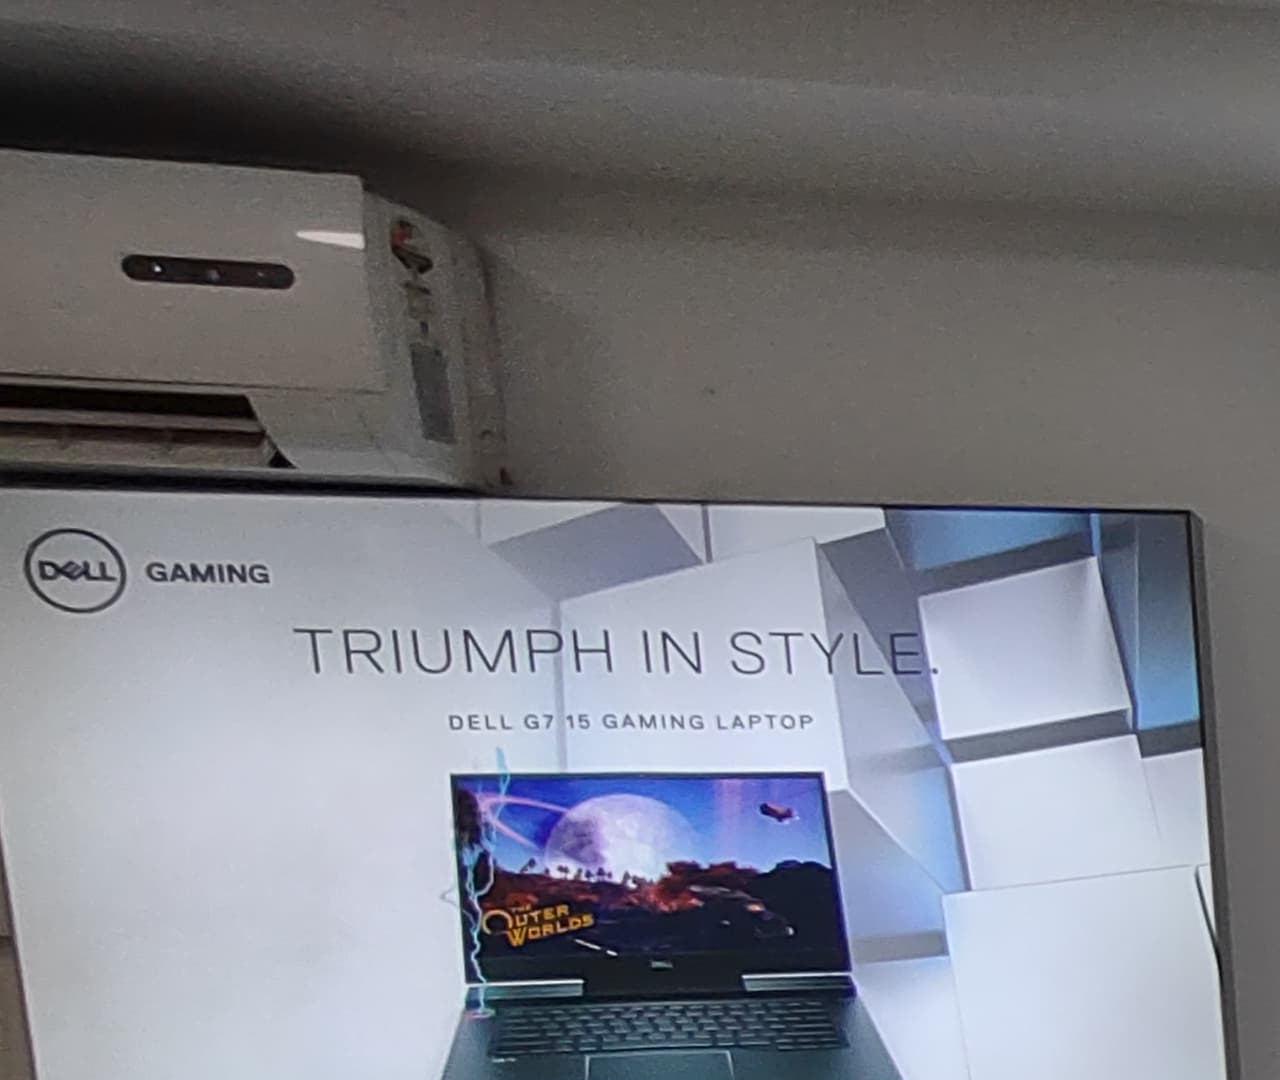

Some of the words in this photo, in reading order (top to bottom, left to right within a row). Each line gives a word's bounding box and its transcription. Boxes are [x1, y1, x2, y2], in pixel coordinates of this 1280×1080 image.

[38, 560, 117, 581] DELL
[146, 562, 270, 583] GAMING
[293, 628, 613, 674] TRIUMPH
[643, 630, 702, 674] IN
[730, 631, 940, 675] STYLE.
[449, 714, 513, 730] DELL
[524, 714, 553, 730] G7
[567, 714, 590, 730] 15
[603, 714, 704, 730] GAMING
[717, 714, 813, 730] LAPTOP
[482, 904, 569, 935] OUTER
[507, 914, 594, 947] WORLDS
